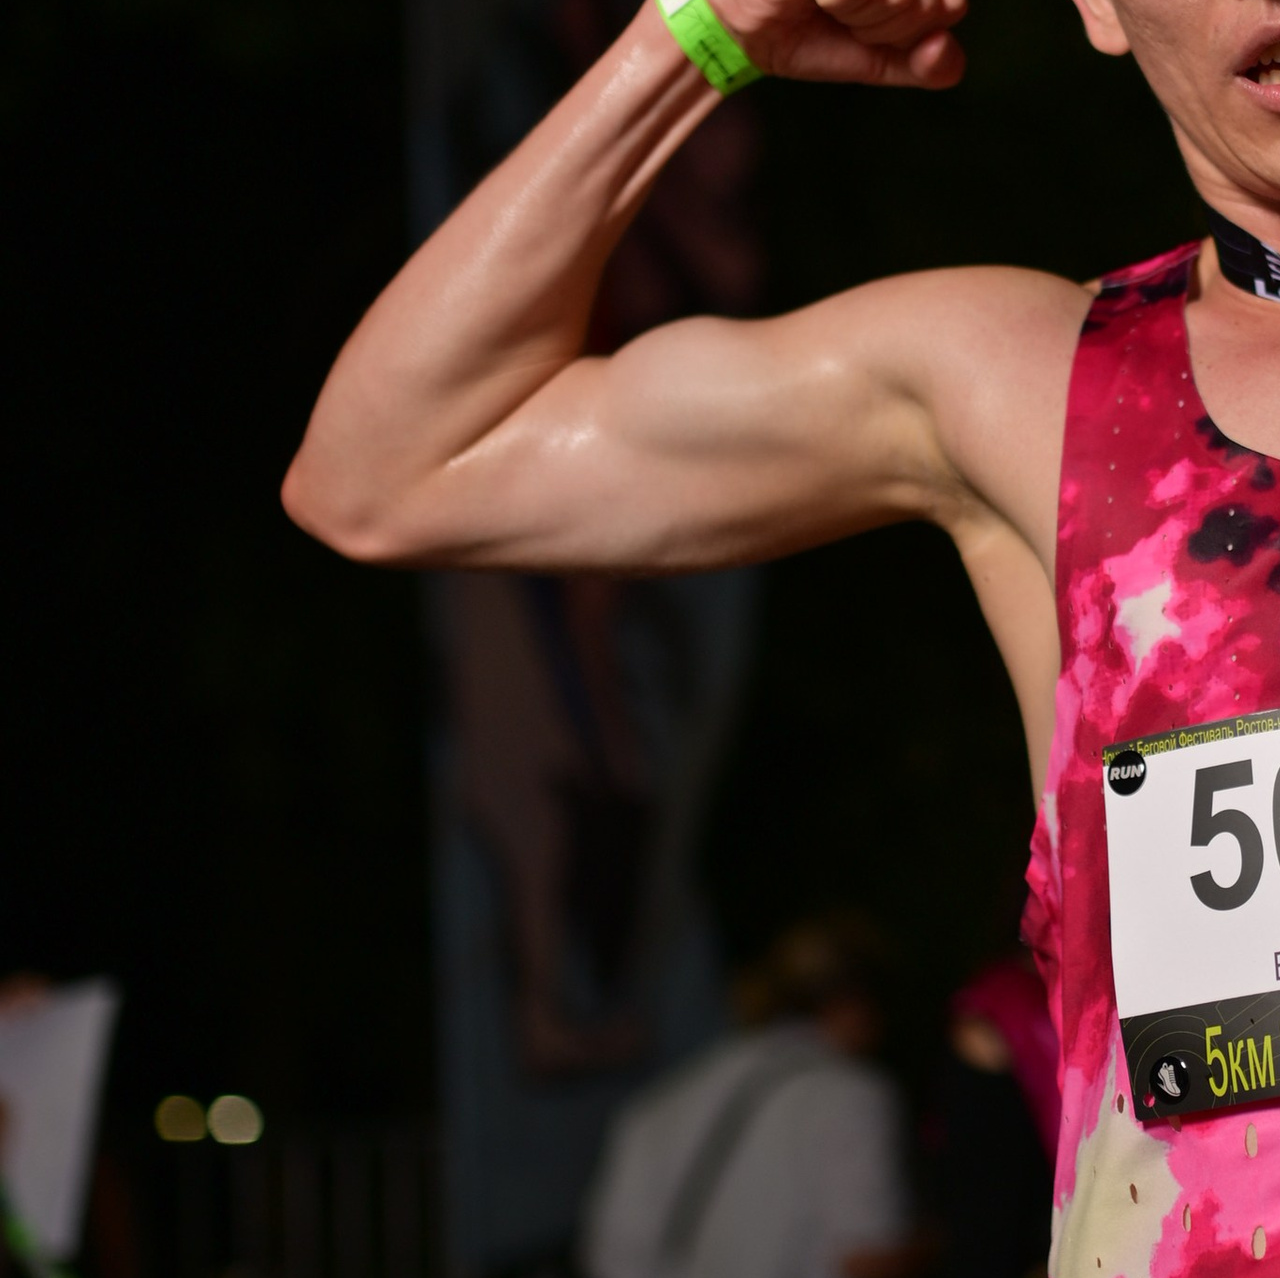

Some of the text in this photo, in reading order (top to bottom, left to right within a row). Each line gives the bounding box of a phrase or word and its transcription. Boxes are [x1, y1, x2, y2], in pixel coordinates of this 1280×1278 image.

[1136, 734, 1177, 757] Беговой
[1179, 725, 1234, 748] Фестиваль
[1109, 765, 1142, 782] RUN
